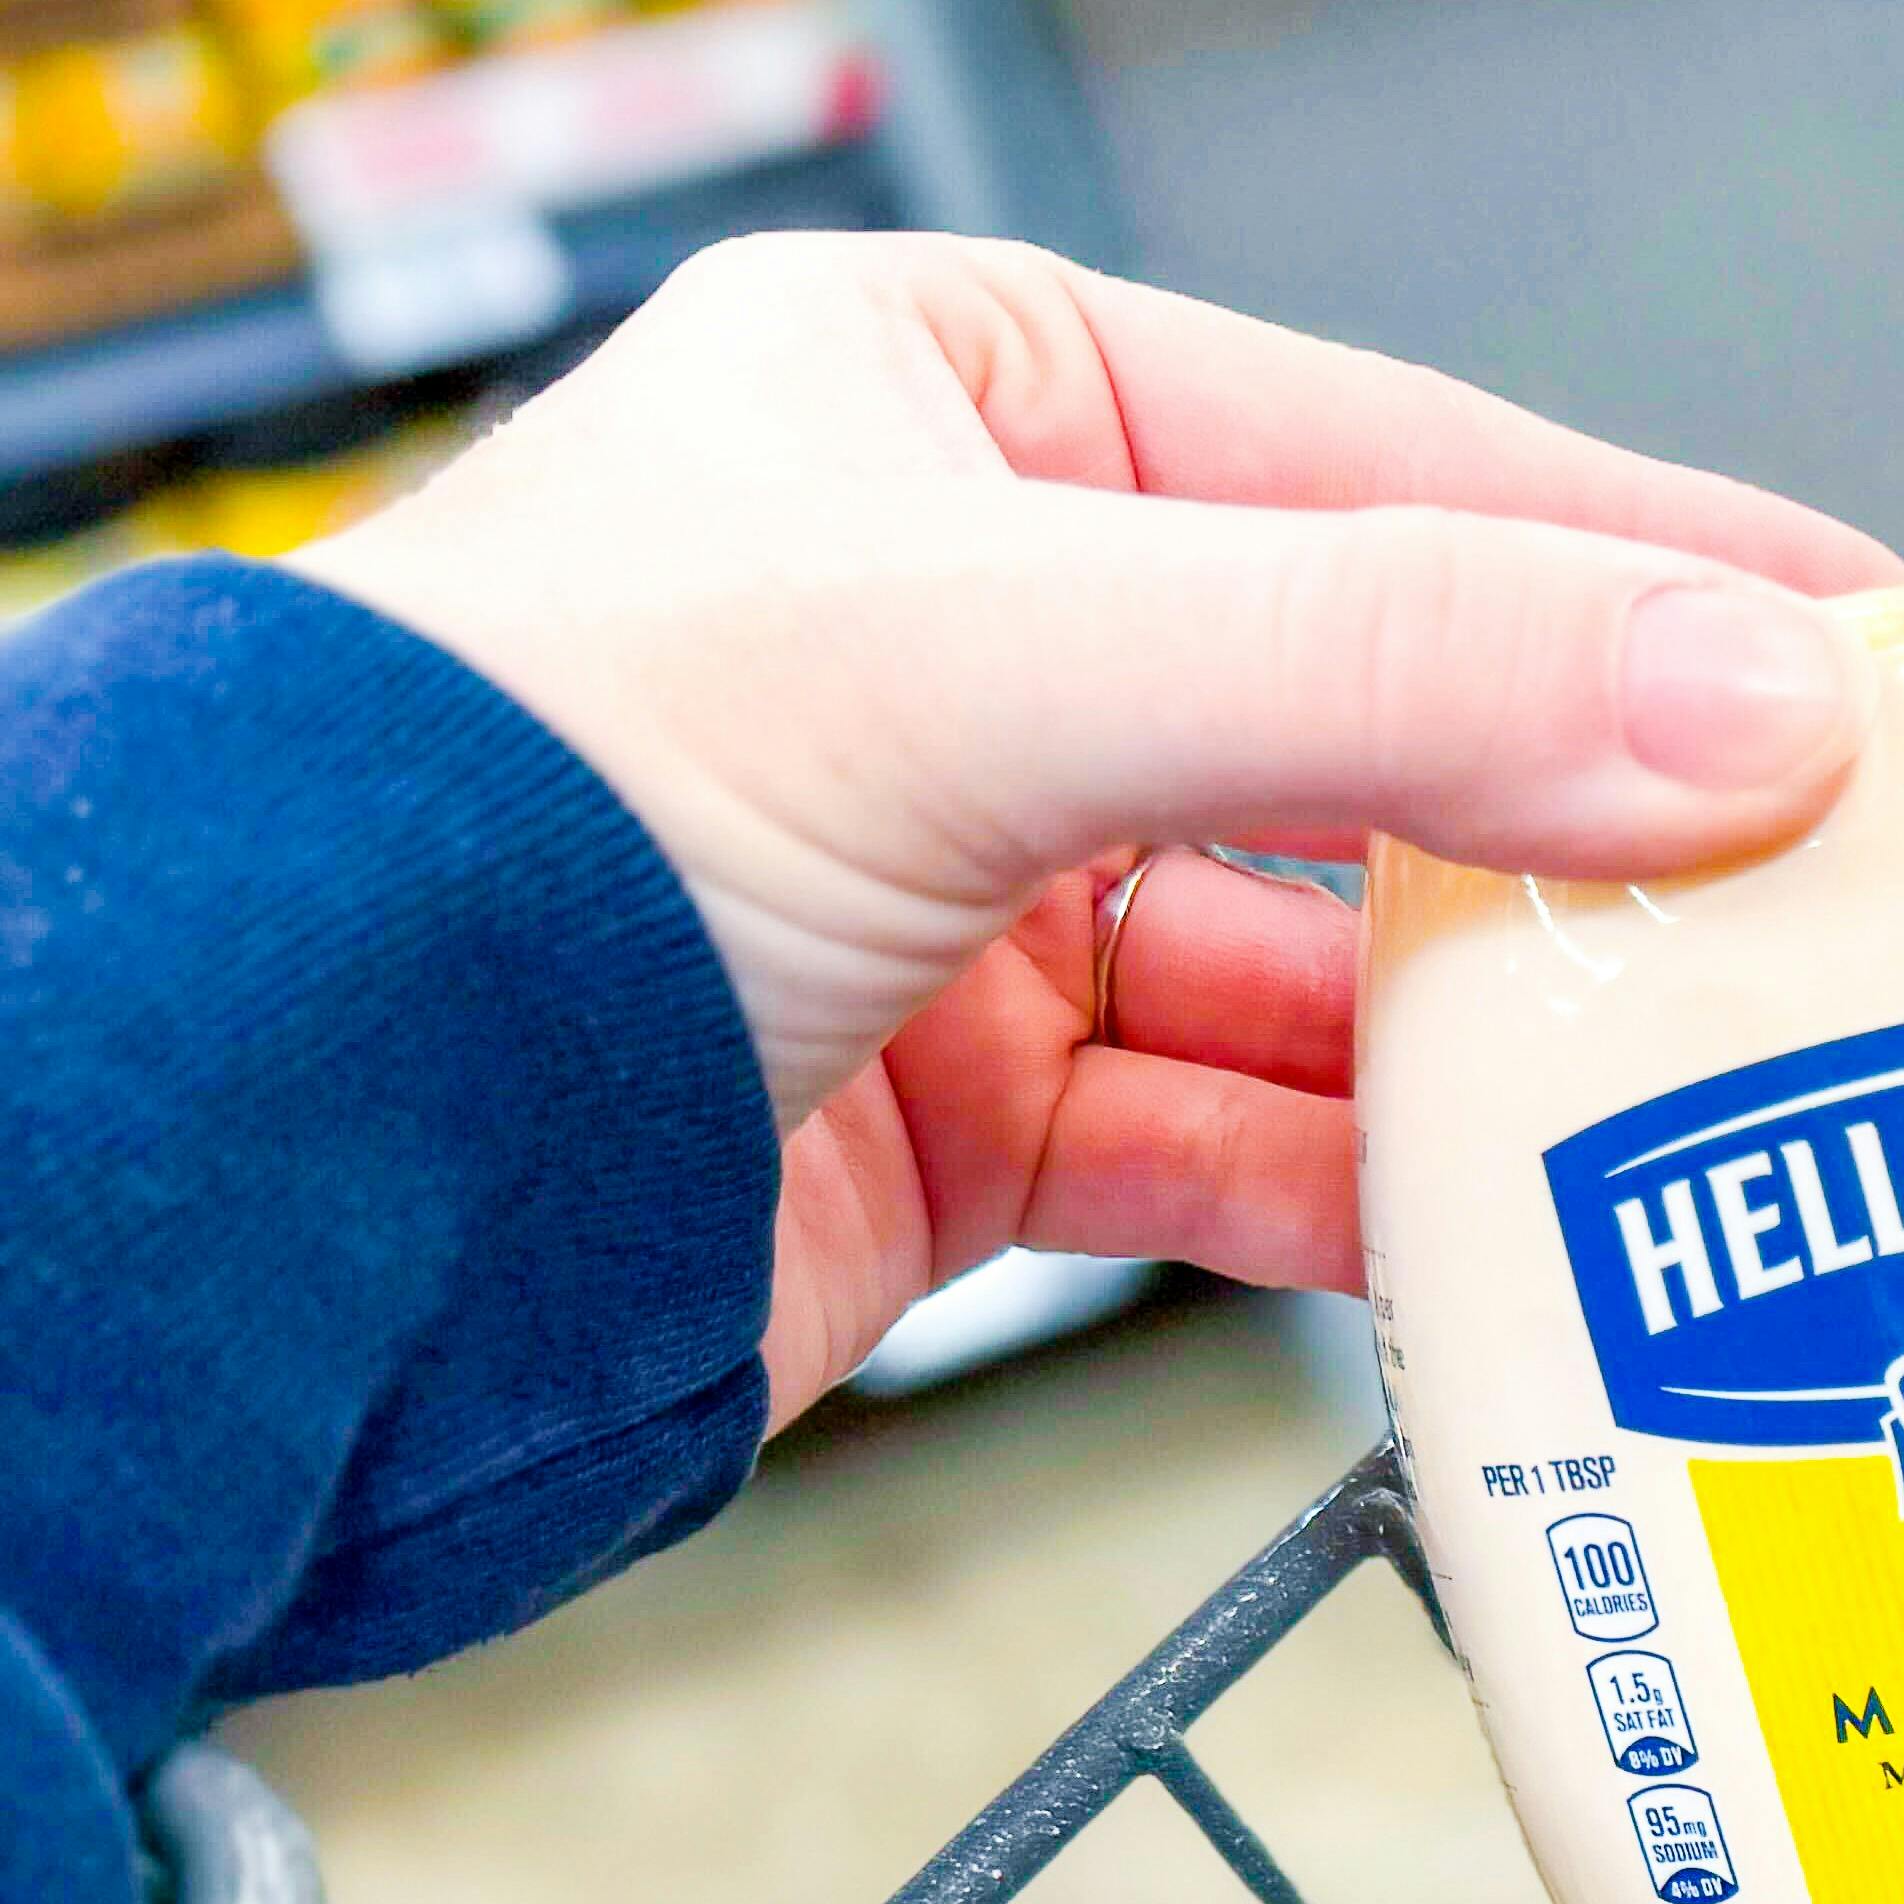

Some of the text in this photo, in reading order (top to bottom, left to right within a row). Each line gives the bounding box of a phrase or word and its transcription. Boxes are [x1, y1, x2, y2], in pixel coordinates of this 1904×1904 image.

[1481, 1455, 1617, 1497] PER 1 TBSP
[1564, 1541, 1635, 1590] 100
[1573, 1593, 1648, 1618] CALORIES
[1613, 1708, 1675, 1732] SAT FAT
[1628, 1746, 1684, 1769] 8% DV
[1652, 1841, 1718, 1863] SODIUM
[1671, 1877, 1723, 1899] 4% DV
